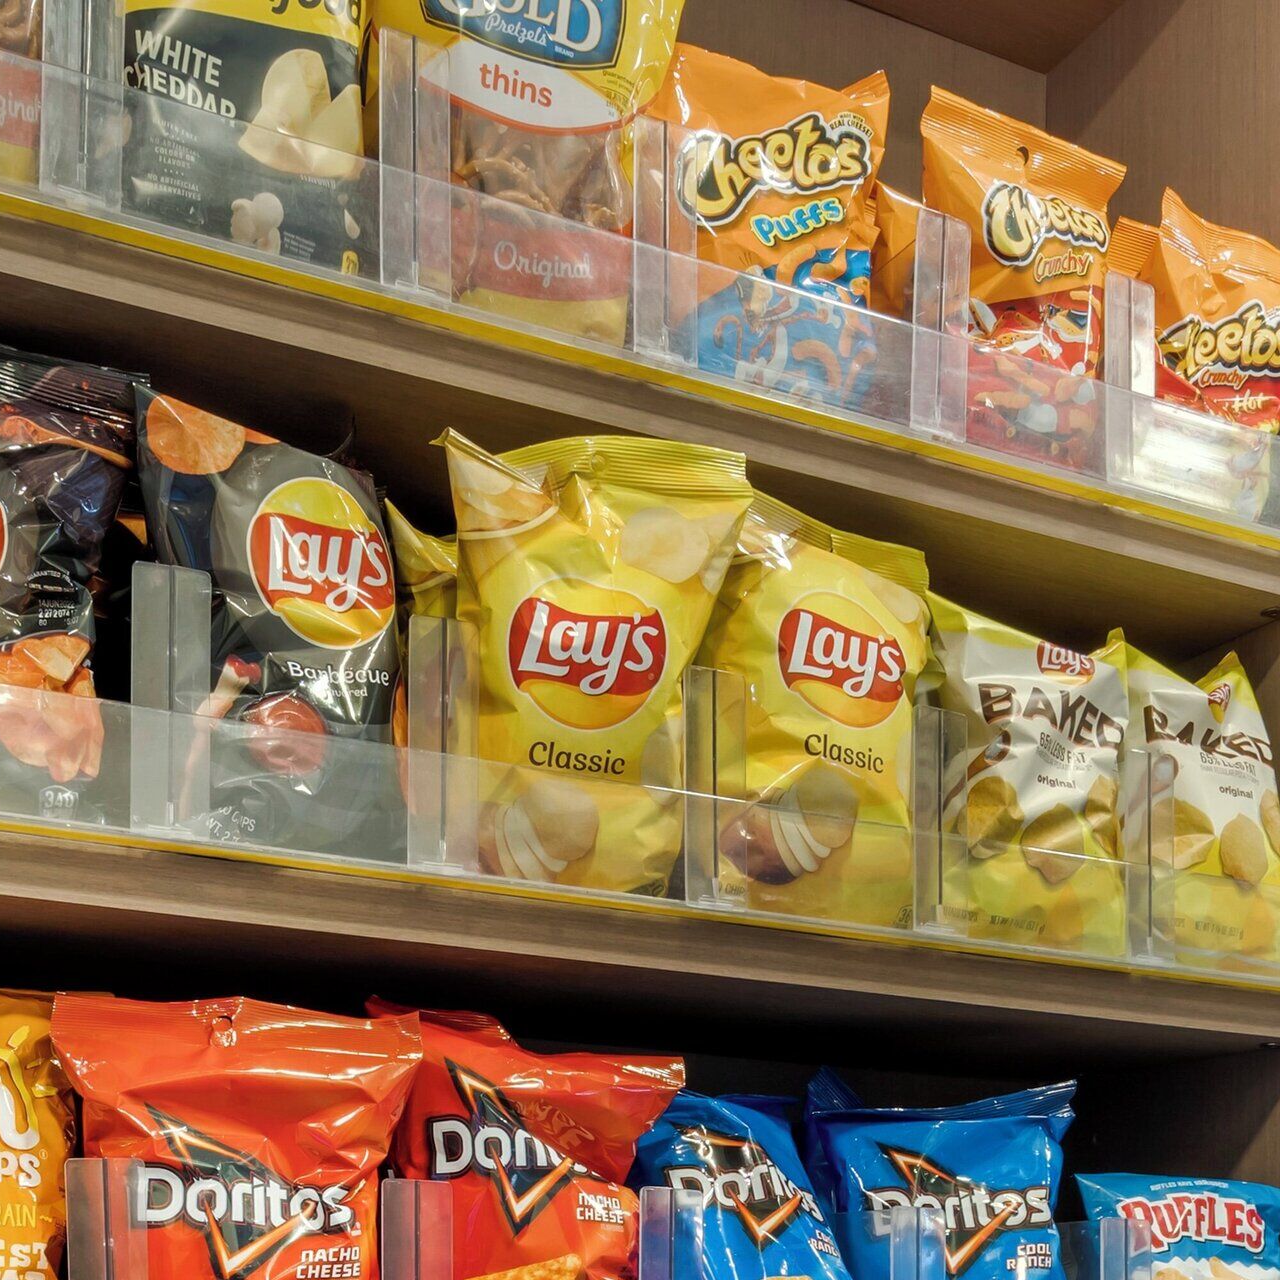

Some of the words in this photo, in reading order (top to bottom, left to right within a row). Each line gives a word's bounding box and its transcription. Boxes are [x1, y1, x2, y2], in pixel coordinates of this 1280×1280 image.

[484, 13, 548, 48] Pretzels
[133, 27, 223, 89] WHITE
[124, 64, 238, 130] CHEDDAR
[479, 62, 554, 108] thins
[678, 115, 870, 224] Cheetos
[751, 197, 844, 246] Puffs
[984, 184, 1108, 262] Cheetos
[493, 239, 594, 289] Original
[1033, 251, 1094, 282] Crunchy
[266, 513, 390, 614] Lay's
[518, 599, 661, 697] Lay's
[787, 610, 904, 698] Lay's
[287, 659, 391, 689] Barbecue
[527, 740, 626, 775] Classic
[803, 732, 885, 774] Classic
[1037, 773, 1077, 790] original
[1218, 784, 1254, 800] original
[135, 1165, 355, 1229] Doritos
[575, 1206, 625, 1225] CHEESE
[577, 1193, 621, 1210] NACHO
[868, 1186, 1052, 1236] Doritos
[1120, 1194, 1266, 1251] RUFFLES
[295, 1262, 361, 1280] CHEESE
[300, 1247, 361, 1265] NACHO
[1016, 1244, 1052, 1257] COOL
